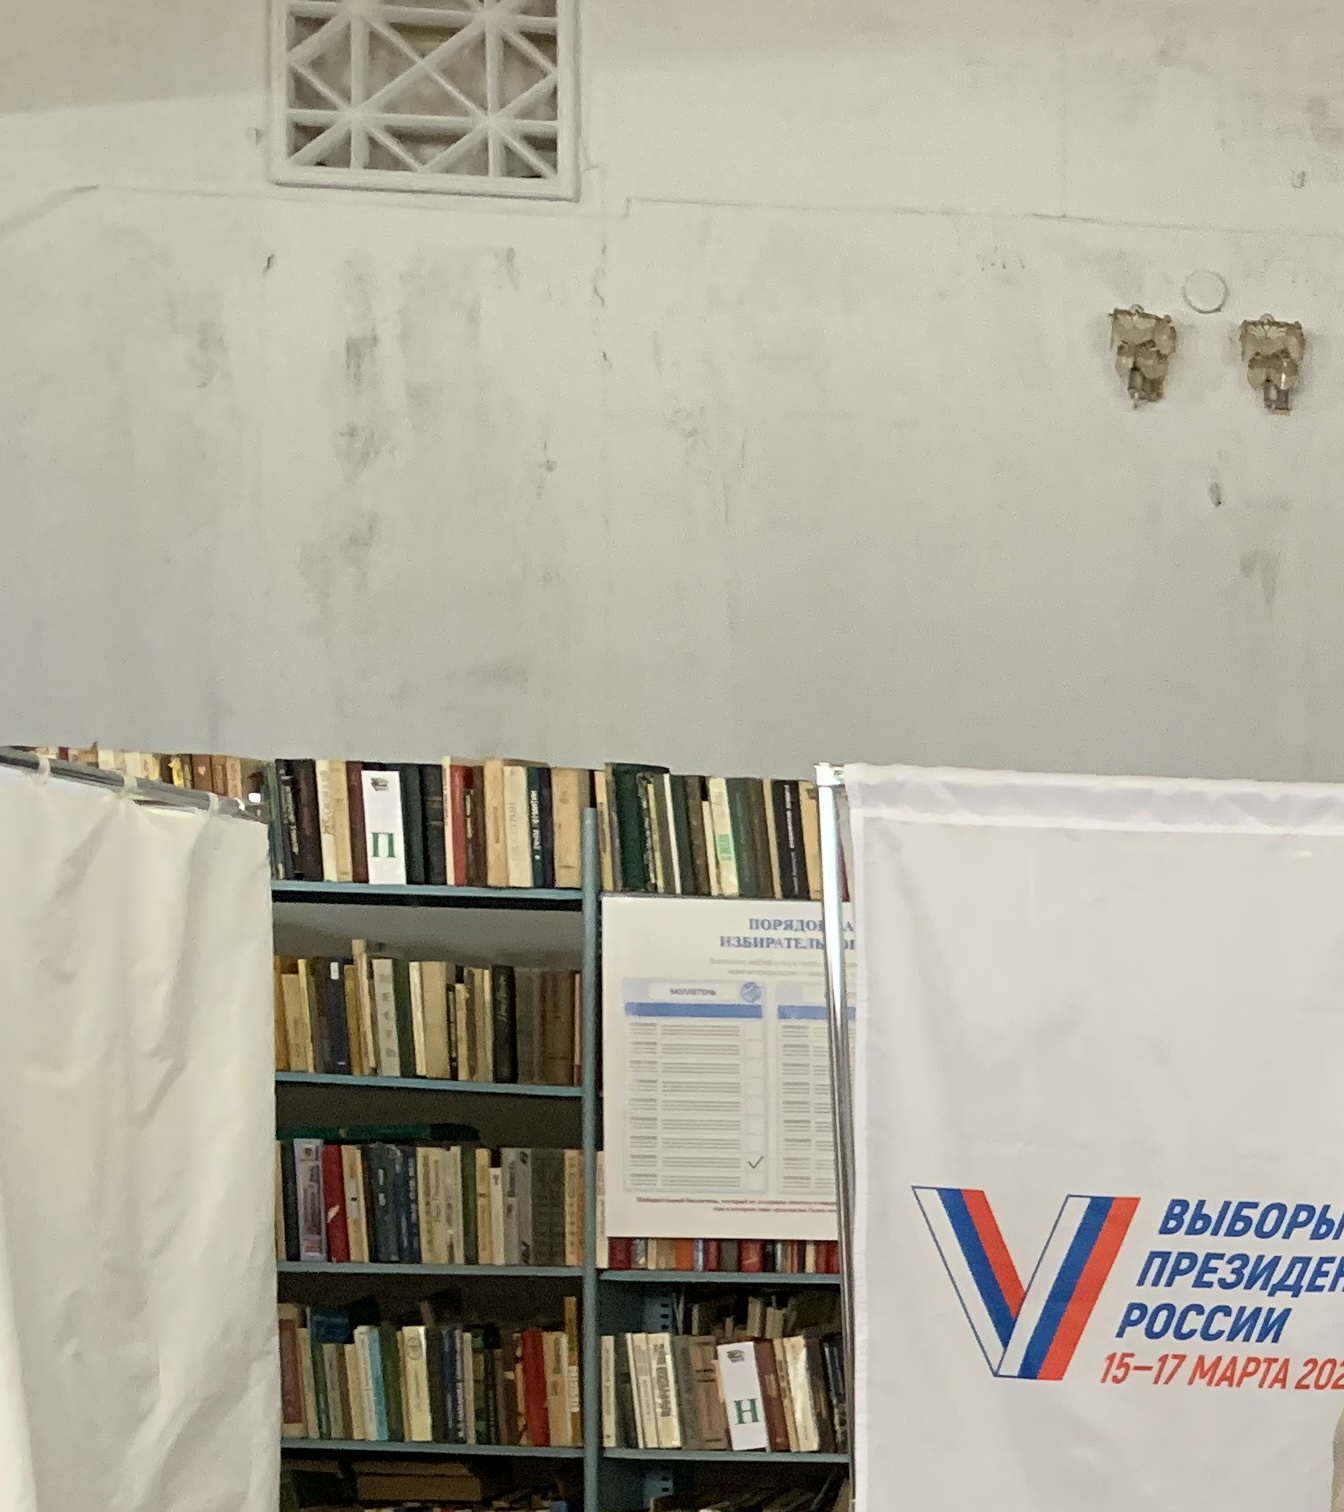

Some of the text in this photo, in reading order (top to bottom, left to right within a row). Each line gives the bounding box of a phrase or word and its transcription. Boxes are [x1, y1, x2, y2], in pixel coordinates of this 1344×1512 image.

[370, 832, 397, 858] П
[719, 935, 855, 950] ИЗБИРАТЕЛЬ
[1115, 1302, 1292, 1343] РОССИИ
[1187, 1354, 1291, 1389] МАРТА
[732, 1397, 760, 1425] Н
